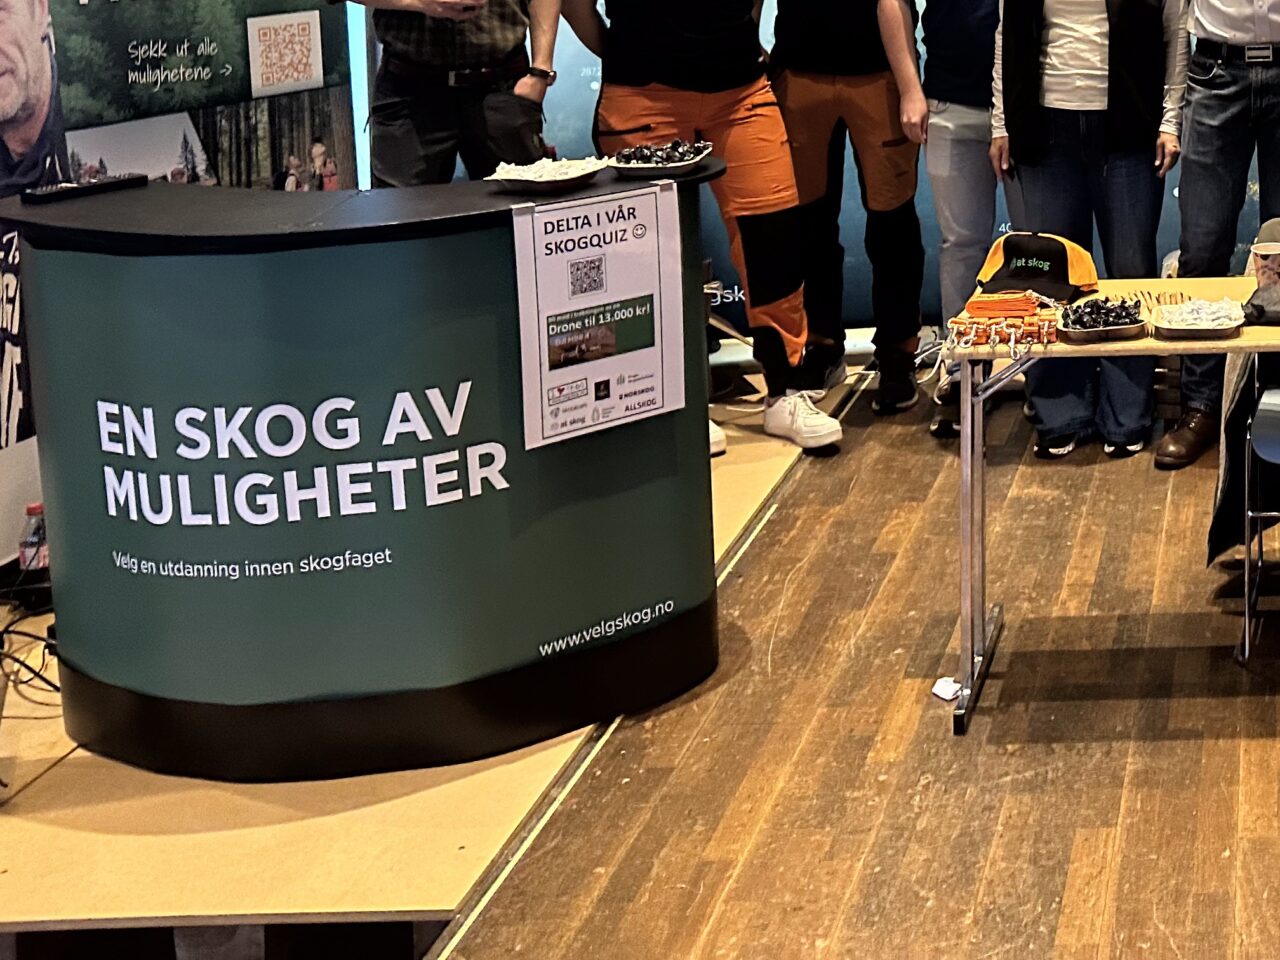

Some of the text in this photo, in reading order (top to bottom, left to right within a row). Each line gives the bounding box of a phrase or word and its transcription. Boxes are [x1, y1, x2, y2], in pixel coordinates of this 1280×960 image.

[128, 36, 218, 65] Sjekk ut alle
[128, 63, 213, 92] mulighetene
[543, 205, 637, 236] DELTA I VÅR
[544, 228, 628, 257] SKOGQUIZ
[1017, 257, 1051, 271] at skog
[549, 320, 582, 335] Drone
[585, 316, 596, 327] til
[599, 307, 634, 324] 13.000
[636, 303, 650, 316] kr!
[96, 380, 472, 460] EN SKOG AV
[624, 398, 656, 412] ALLSKOG
[103, 441, 510, 526] MULIGHETER
[112, 548, 393, 580] Velg en utdanning innen skogfaget
[538, 600, 674, 657] www.velgskog.no
